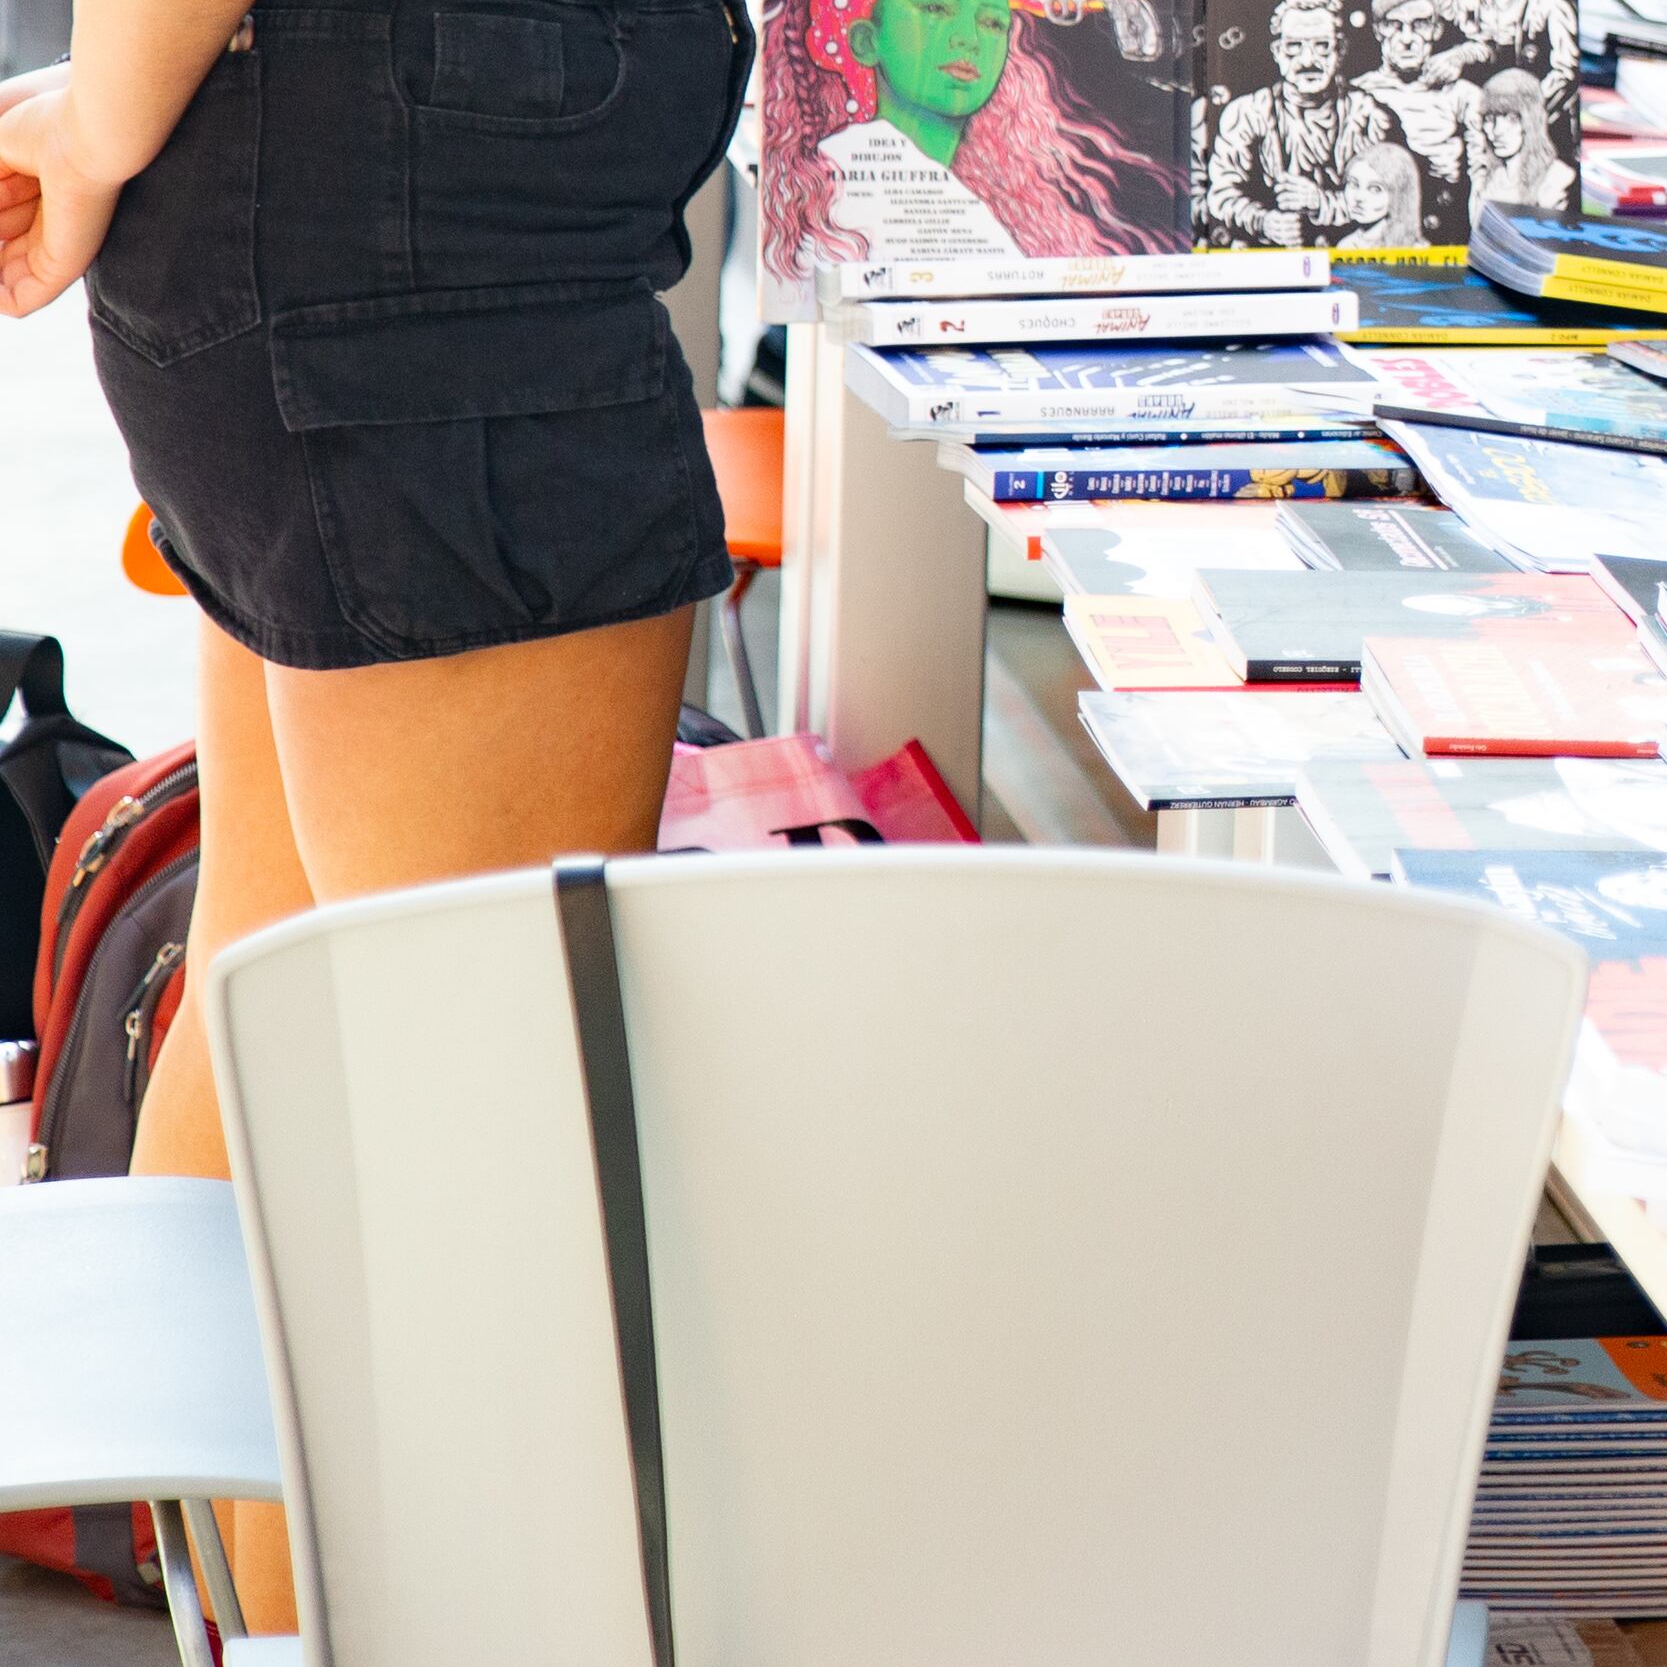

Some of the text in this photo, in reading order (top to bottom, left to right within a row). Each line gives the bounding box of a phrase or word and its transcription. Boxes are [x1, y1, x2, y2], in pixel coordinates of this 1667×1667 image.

[868, 138, 897, 148] IDEA
[851, 152, 903, 162] DIBUJOS
[880, 170, 951, 183] GIUFFRA
[986, 269, 1044, 281] ROTURAS
[1058, 265, 1125, 289] ANIMAL
[939, 313, 1151, 334] ANIMAL CHOQUES 2
[1039, 405, 1115, 419] ARRANQUES
[1272, 665, 1340, 673] EZEQUIEL COUSELO
[1213, 798, 1288, 810] AGRIMBAU HERNÁN
